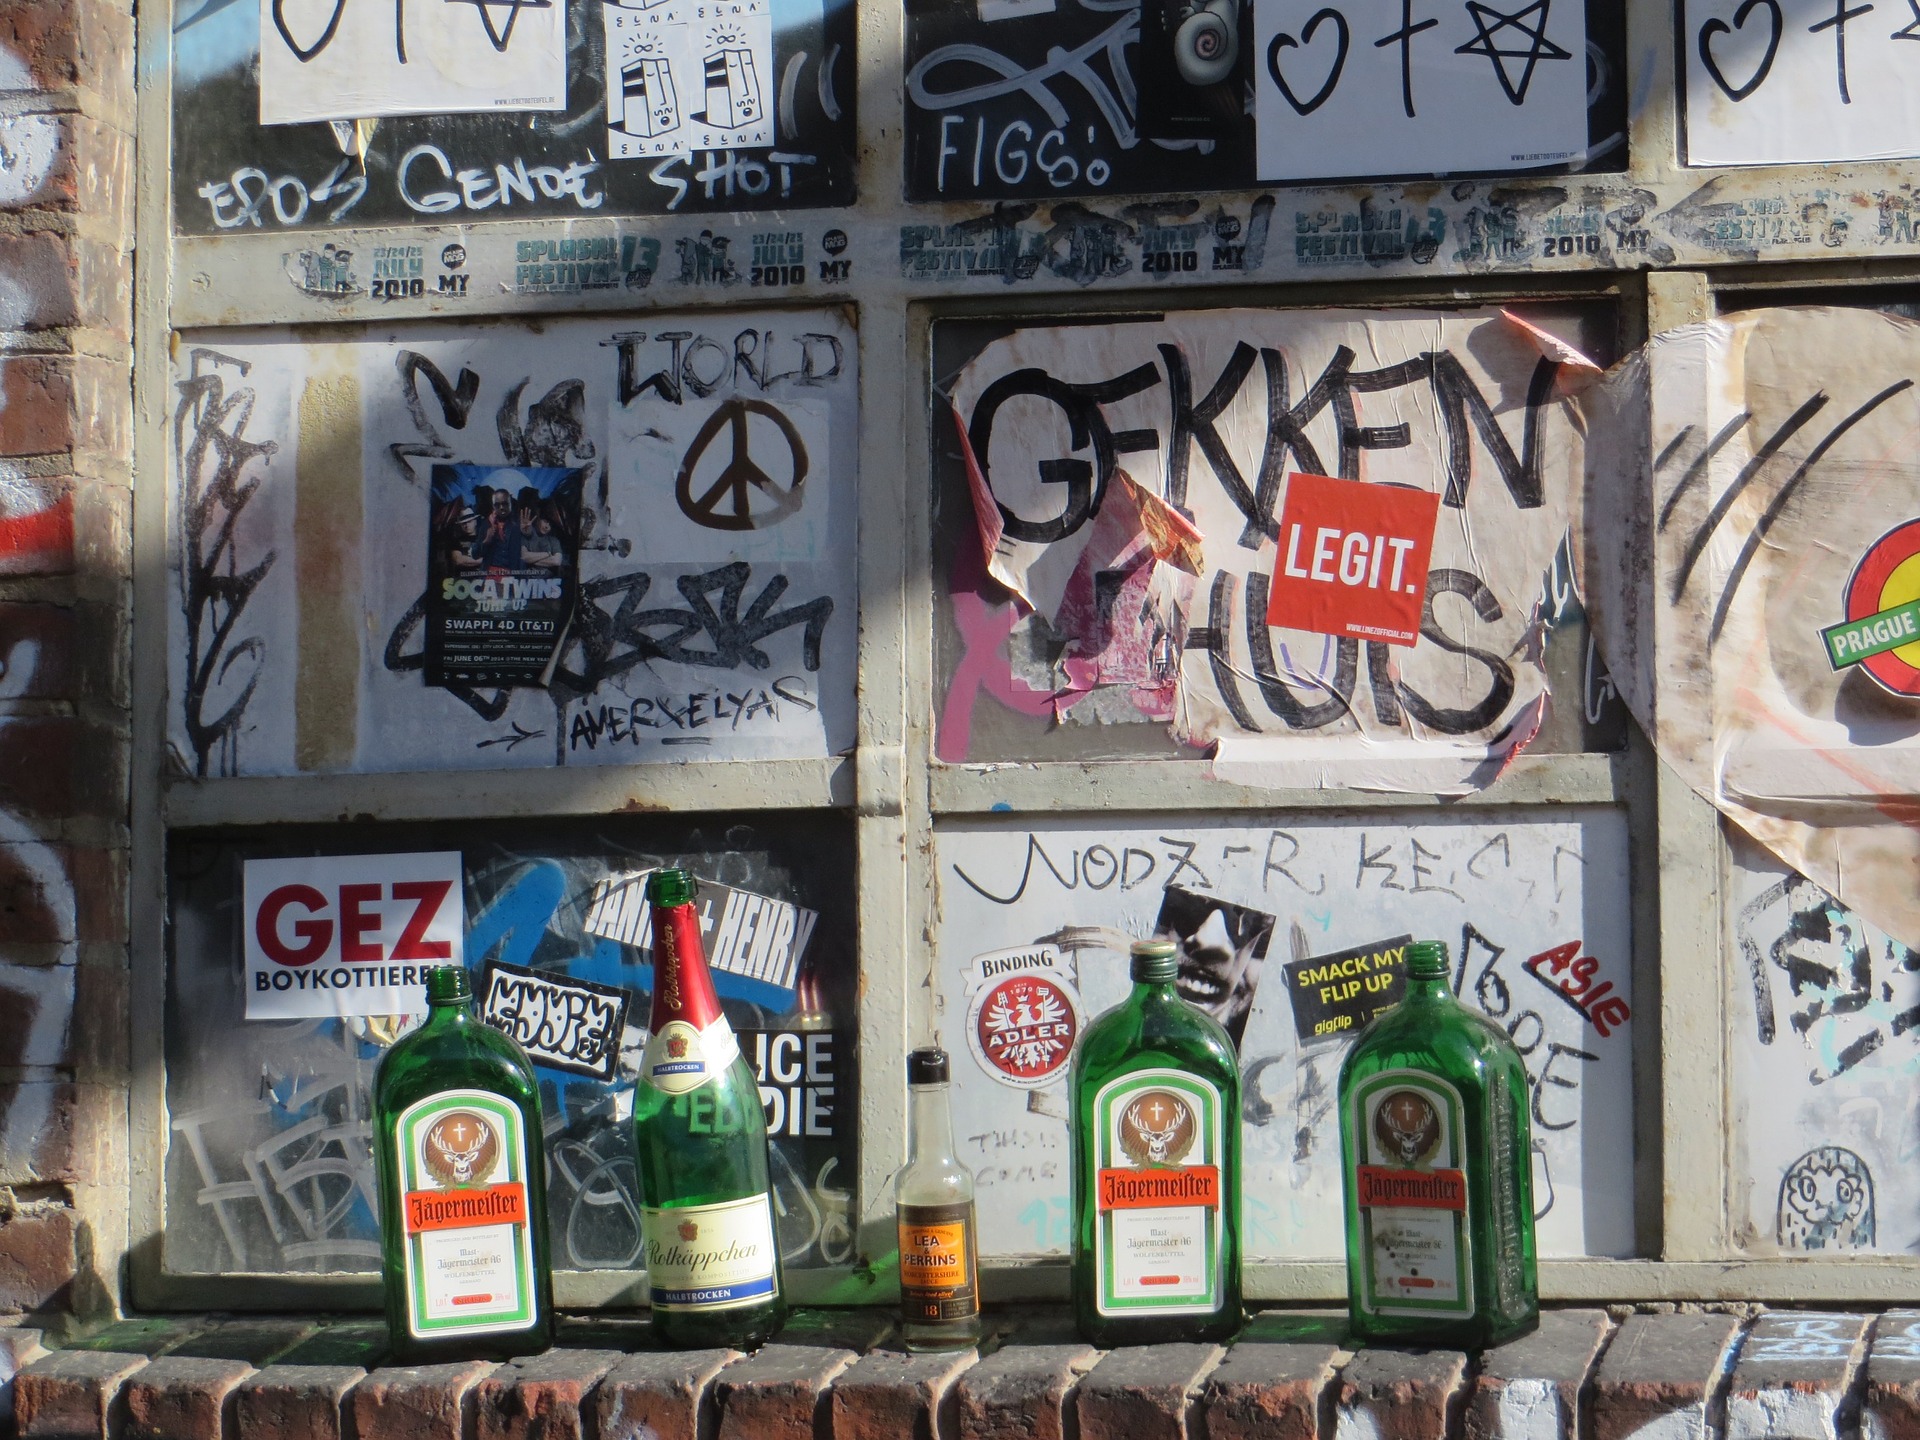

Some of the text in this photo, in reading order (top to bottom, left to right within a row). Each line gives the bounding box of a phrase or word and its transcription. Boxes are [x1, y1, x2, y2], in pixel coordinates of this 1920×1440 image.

[516, 238, 618, 262] SPLASH!
[752, 246, 804, 266] JULY
[1544, 236, 1600, 258] 2010
[373, 258, 424, 278] JULY
[516, 261, 620, 285] FESTIVAL
[820, 260, 852, 279] MY
[1142, 251, 1198, 273] 2010
[439, 274, 470, 293] MY
[751, 265, 806, 287] 2010
[372, 279, 425, 299] 2010
[600, 328, 845, 406] WORLD
[1285, 523, 1416, 594] LEGIT.
[442, 576, 562, 600] SOCA TWINS
[445, 619, 555, 632] SWAPPI 4D (T&T)
[1832, 612, 1917, 658] PRAGUE
[453, 655, 472, 663] JUNE
[256, 880, 454, 967] GEZ
[710, 888, 820, 990] HENRY
[981, 949, 1053, 979] BINDING
[1298, 946, 1405, 987] SMACK MY
[256, 965, 440, 992] BOYKOTTIERE
[1320, 972, 1393, 1004] FLIP UP
[1009, 986, 1033, 995] 1870
[989, 1023, 1070, 1048] ADLER
[914, 1235, 940, 1247] LEA
[645, 1238, 758, 1272] Rotkäppchen
[904, 1253, 957, 1267] PERRINS
[666, 1288, 731, 1303] HALBTROCKEN
[925, 1305, 938, 1316] 18
